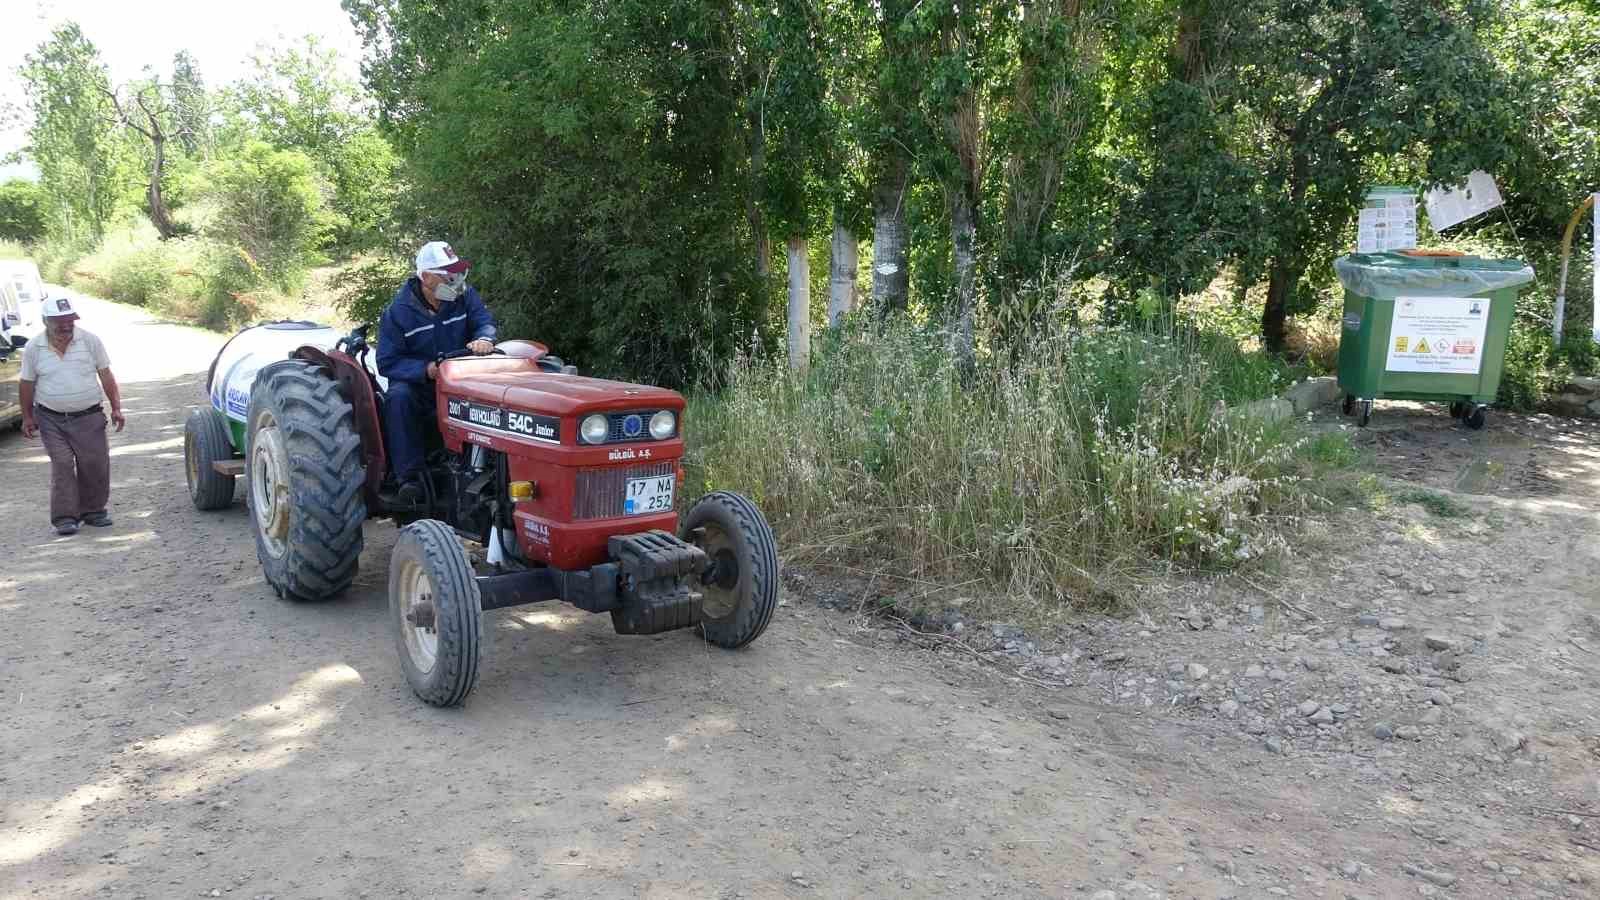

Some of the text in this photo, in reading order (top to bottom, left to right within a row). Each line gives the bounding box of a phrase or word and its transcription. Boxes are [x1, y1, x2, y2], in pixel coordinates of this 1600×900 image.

[508, 412, 554, 437] 54C Junior
[631, 479, 672, 497] 17 NA
[648, 495, 671, 510] 252
